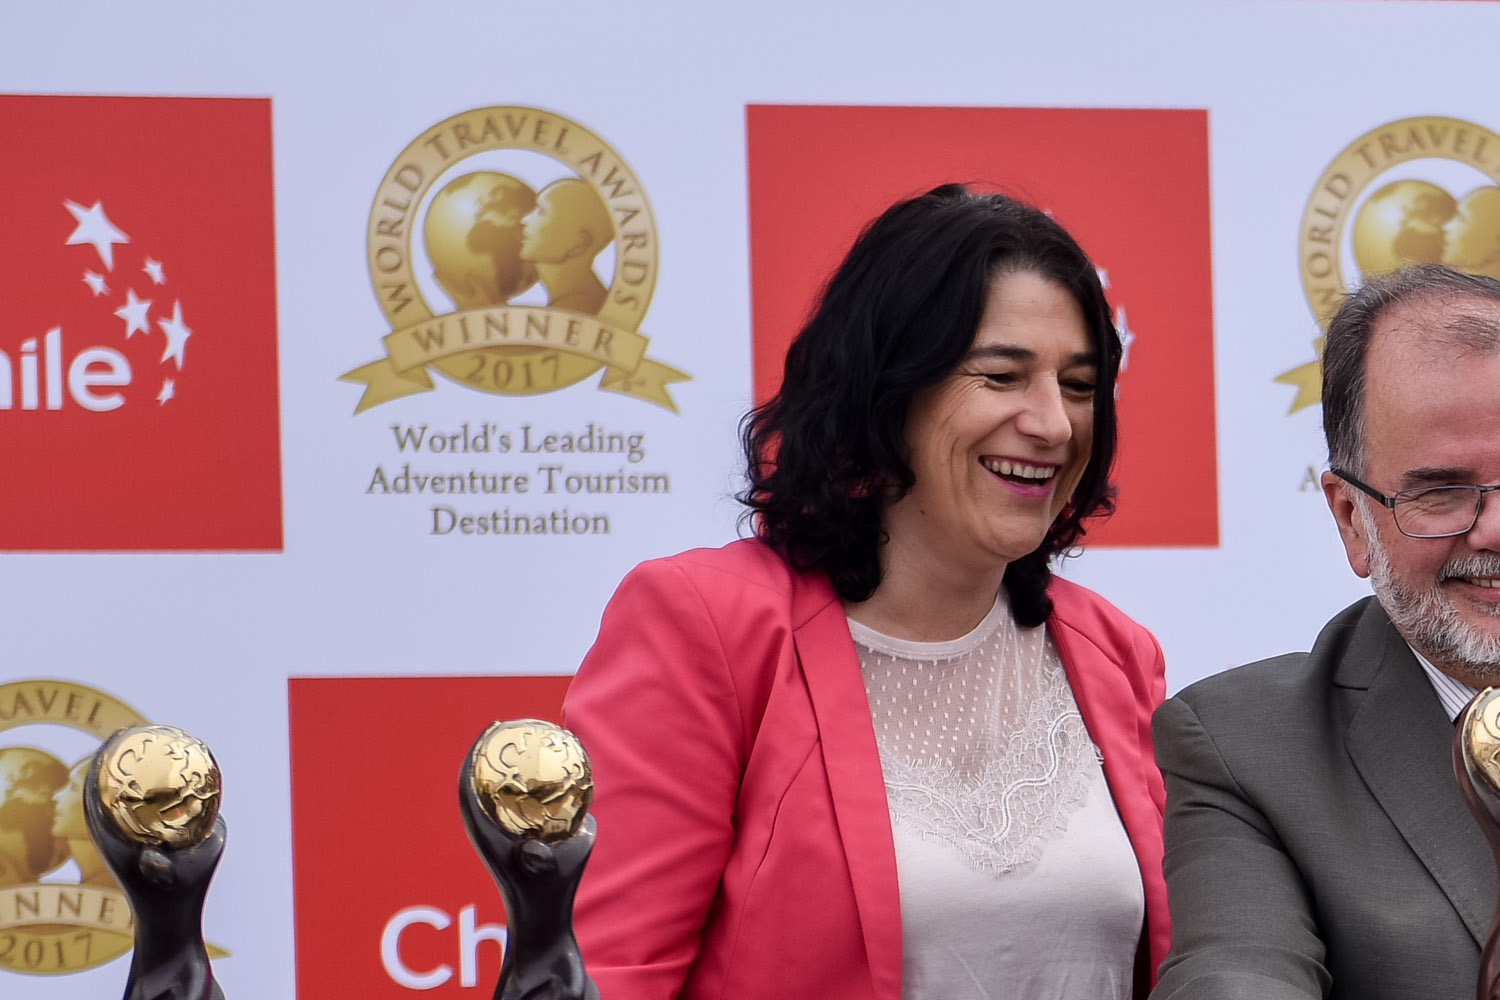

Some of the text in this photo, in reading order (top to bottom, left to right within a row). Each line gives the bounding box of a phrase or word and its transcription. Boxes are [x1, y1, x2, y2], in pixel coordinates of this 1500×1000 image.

[1352, 125, 1491, 169] TRAVEL
[376, 114, 647, 314] WORLD TRAVEL AWARDS
[412, 313, 614, 356] WINNER
[0, 325, 133, 412] ile
[466, 355, 559, 389] 2017
[390, 423, 645, 463] World's Leading
[364, 464, 671, 494] Adventure Tourism
[430, 505, 610, 535] Destination
[0, 689, 108, 723] AVEL
[0, 933, 93, 969] 2017
